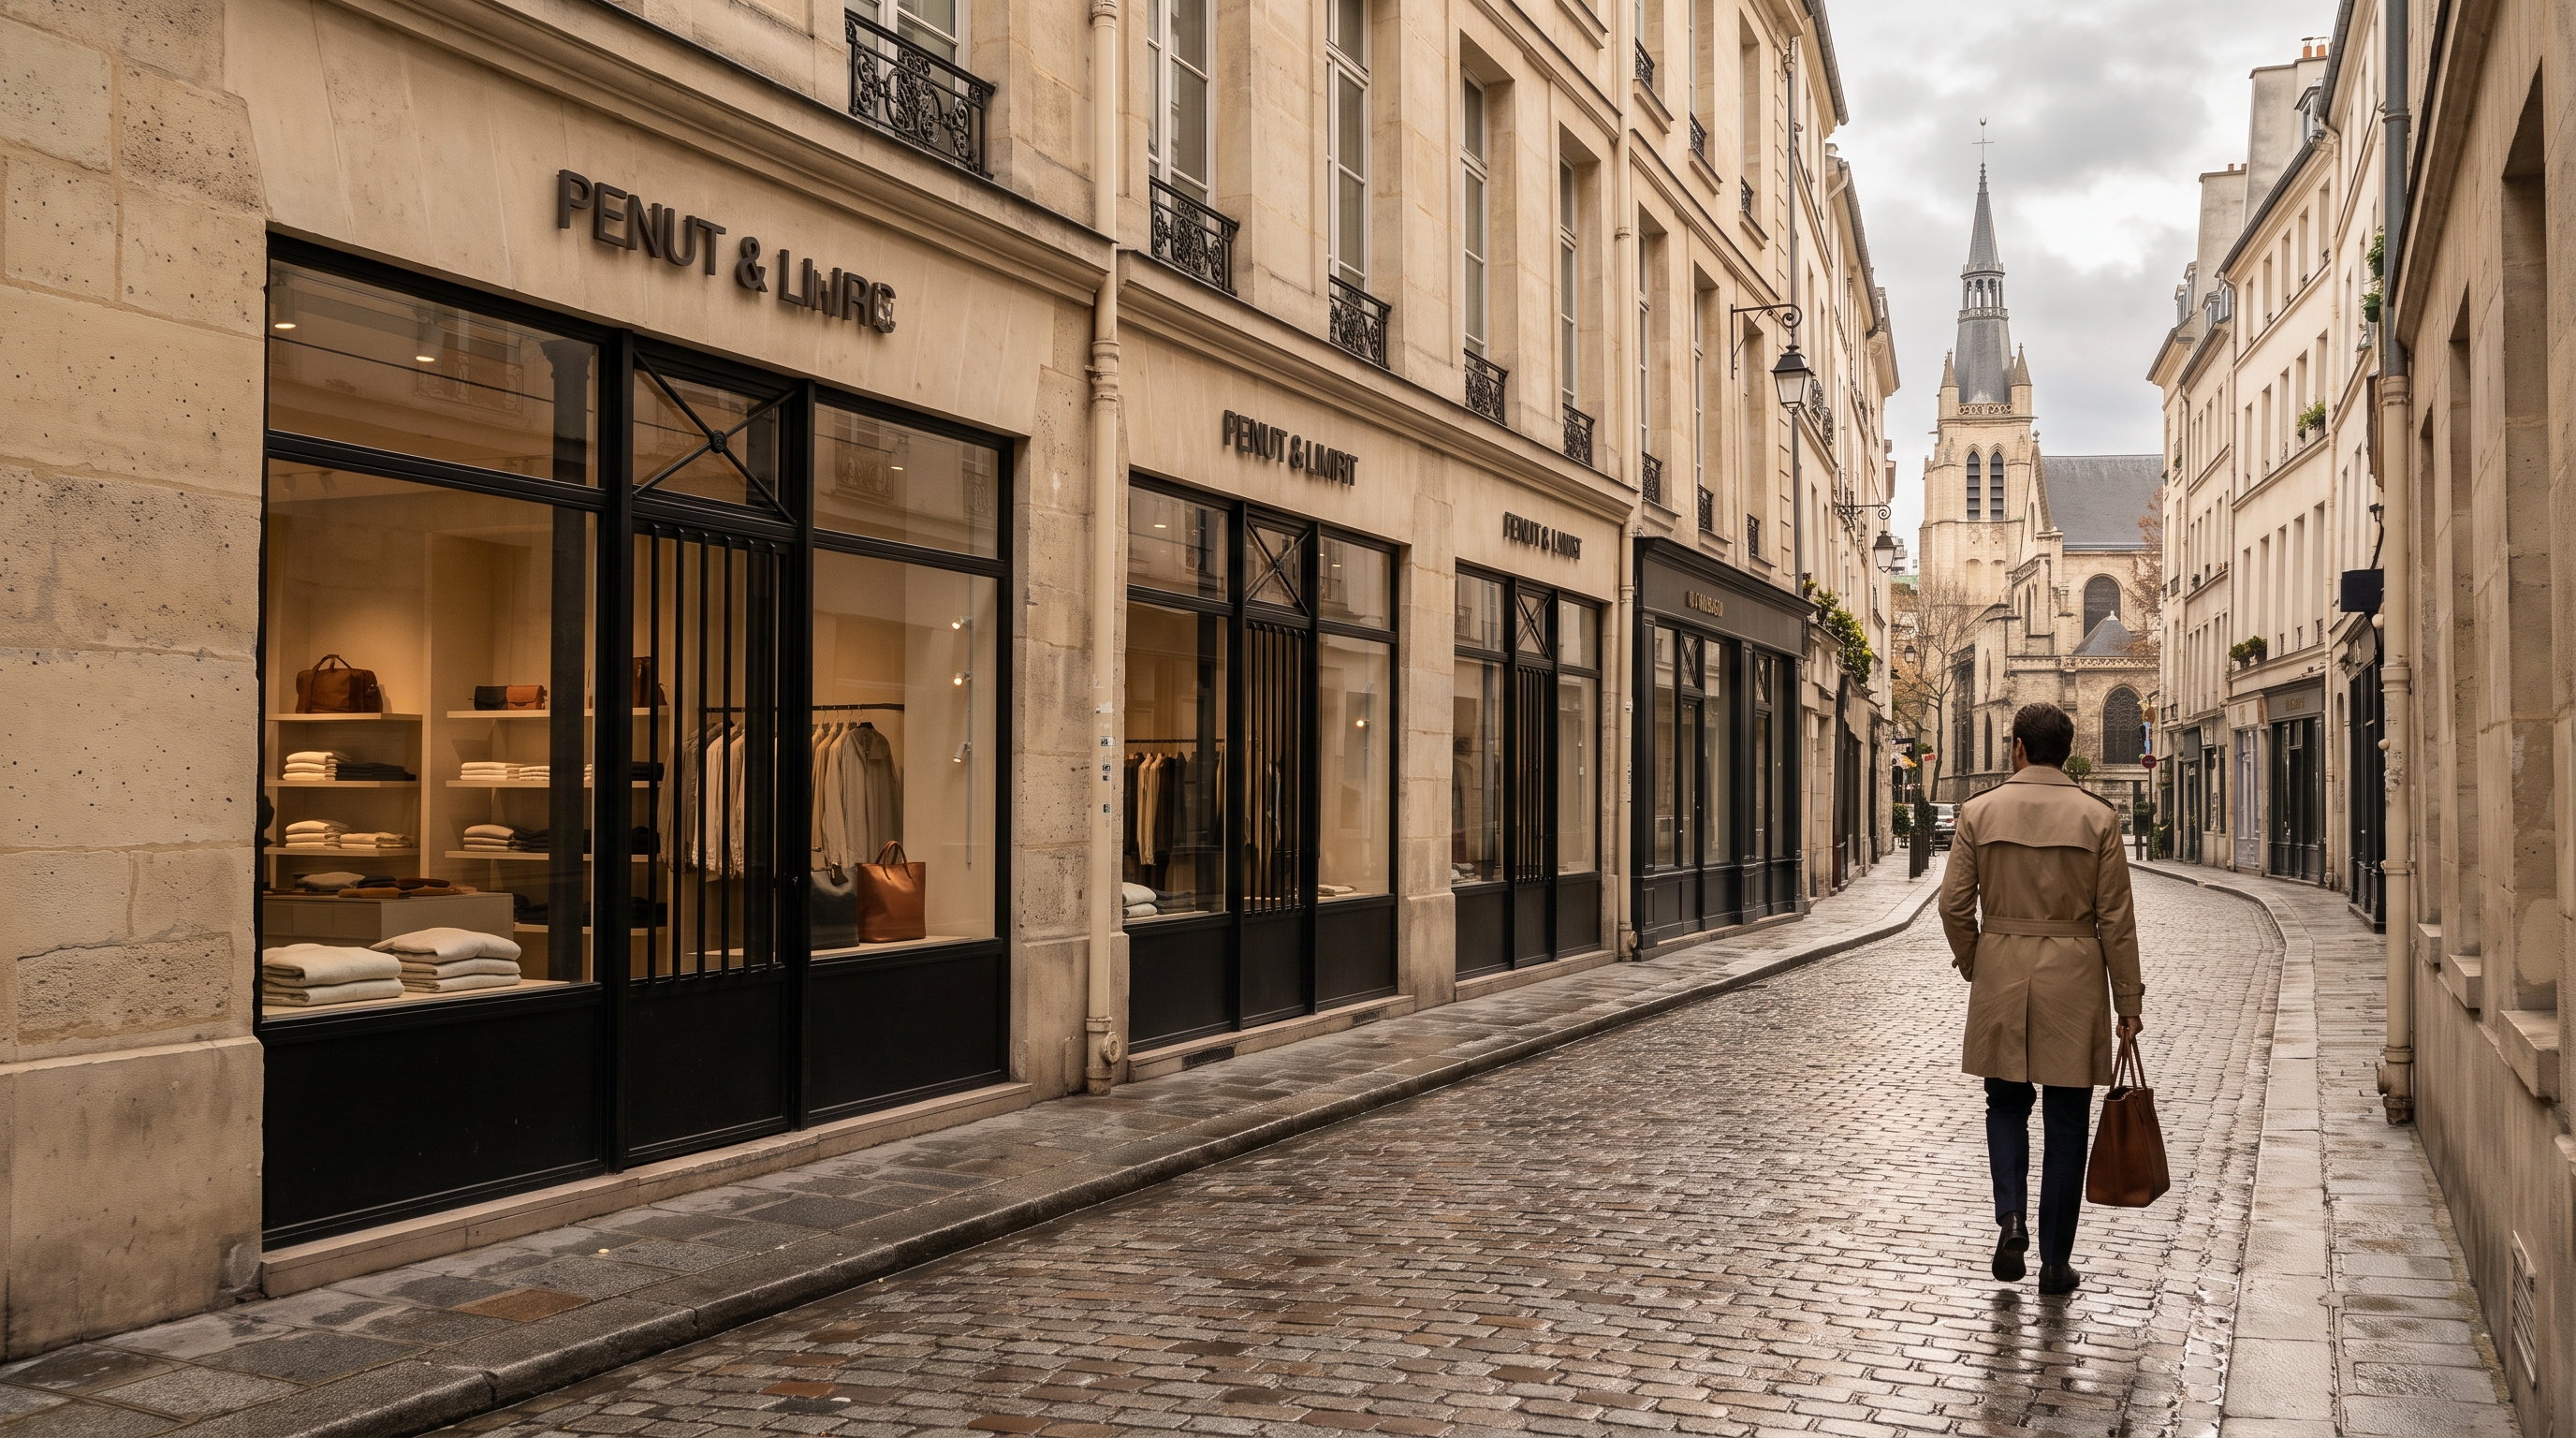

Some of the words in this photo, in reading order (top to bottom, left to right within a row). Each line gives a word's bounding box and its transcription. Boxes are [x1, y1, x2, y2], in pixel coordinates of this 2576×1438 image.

[557, 169, 726, 275] PENUT
[736, 236, 768, 293] &
[1223, 409, 1287, 462] PENUT
[1292, 434, 1304, 468] &
